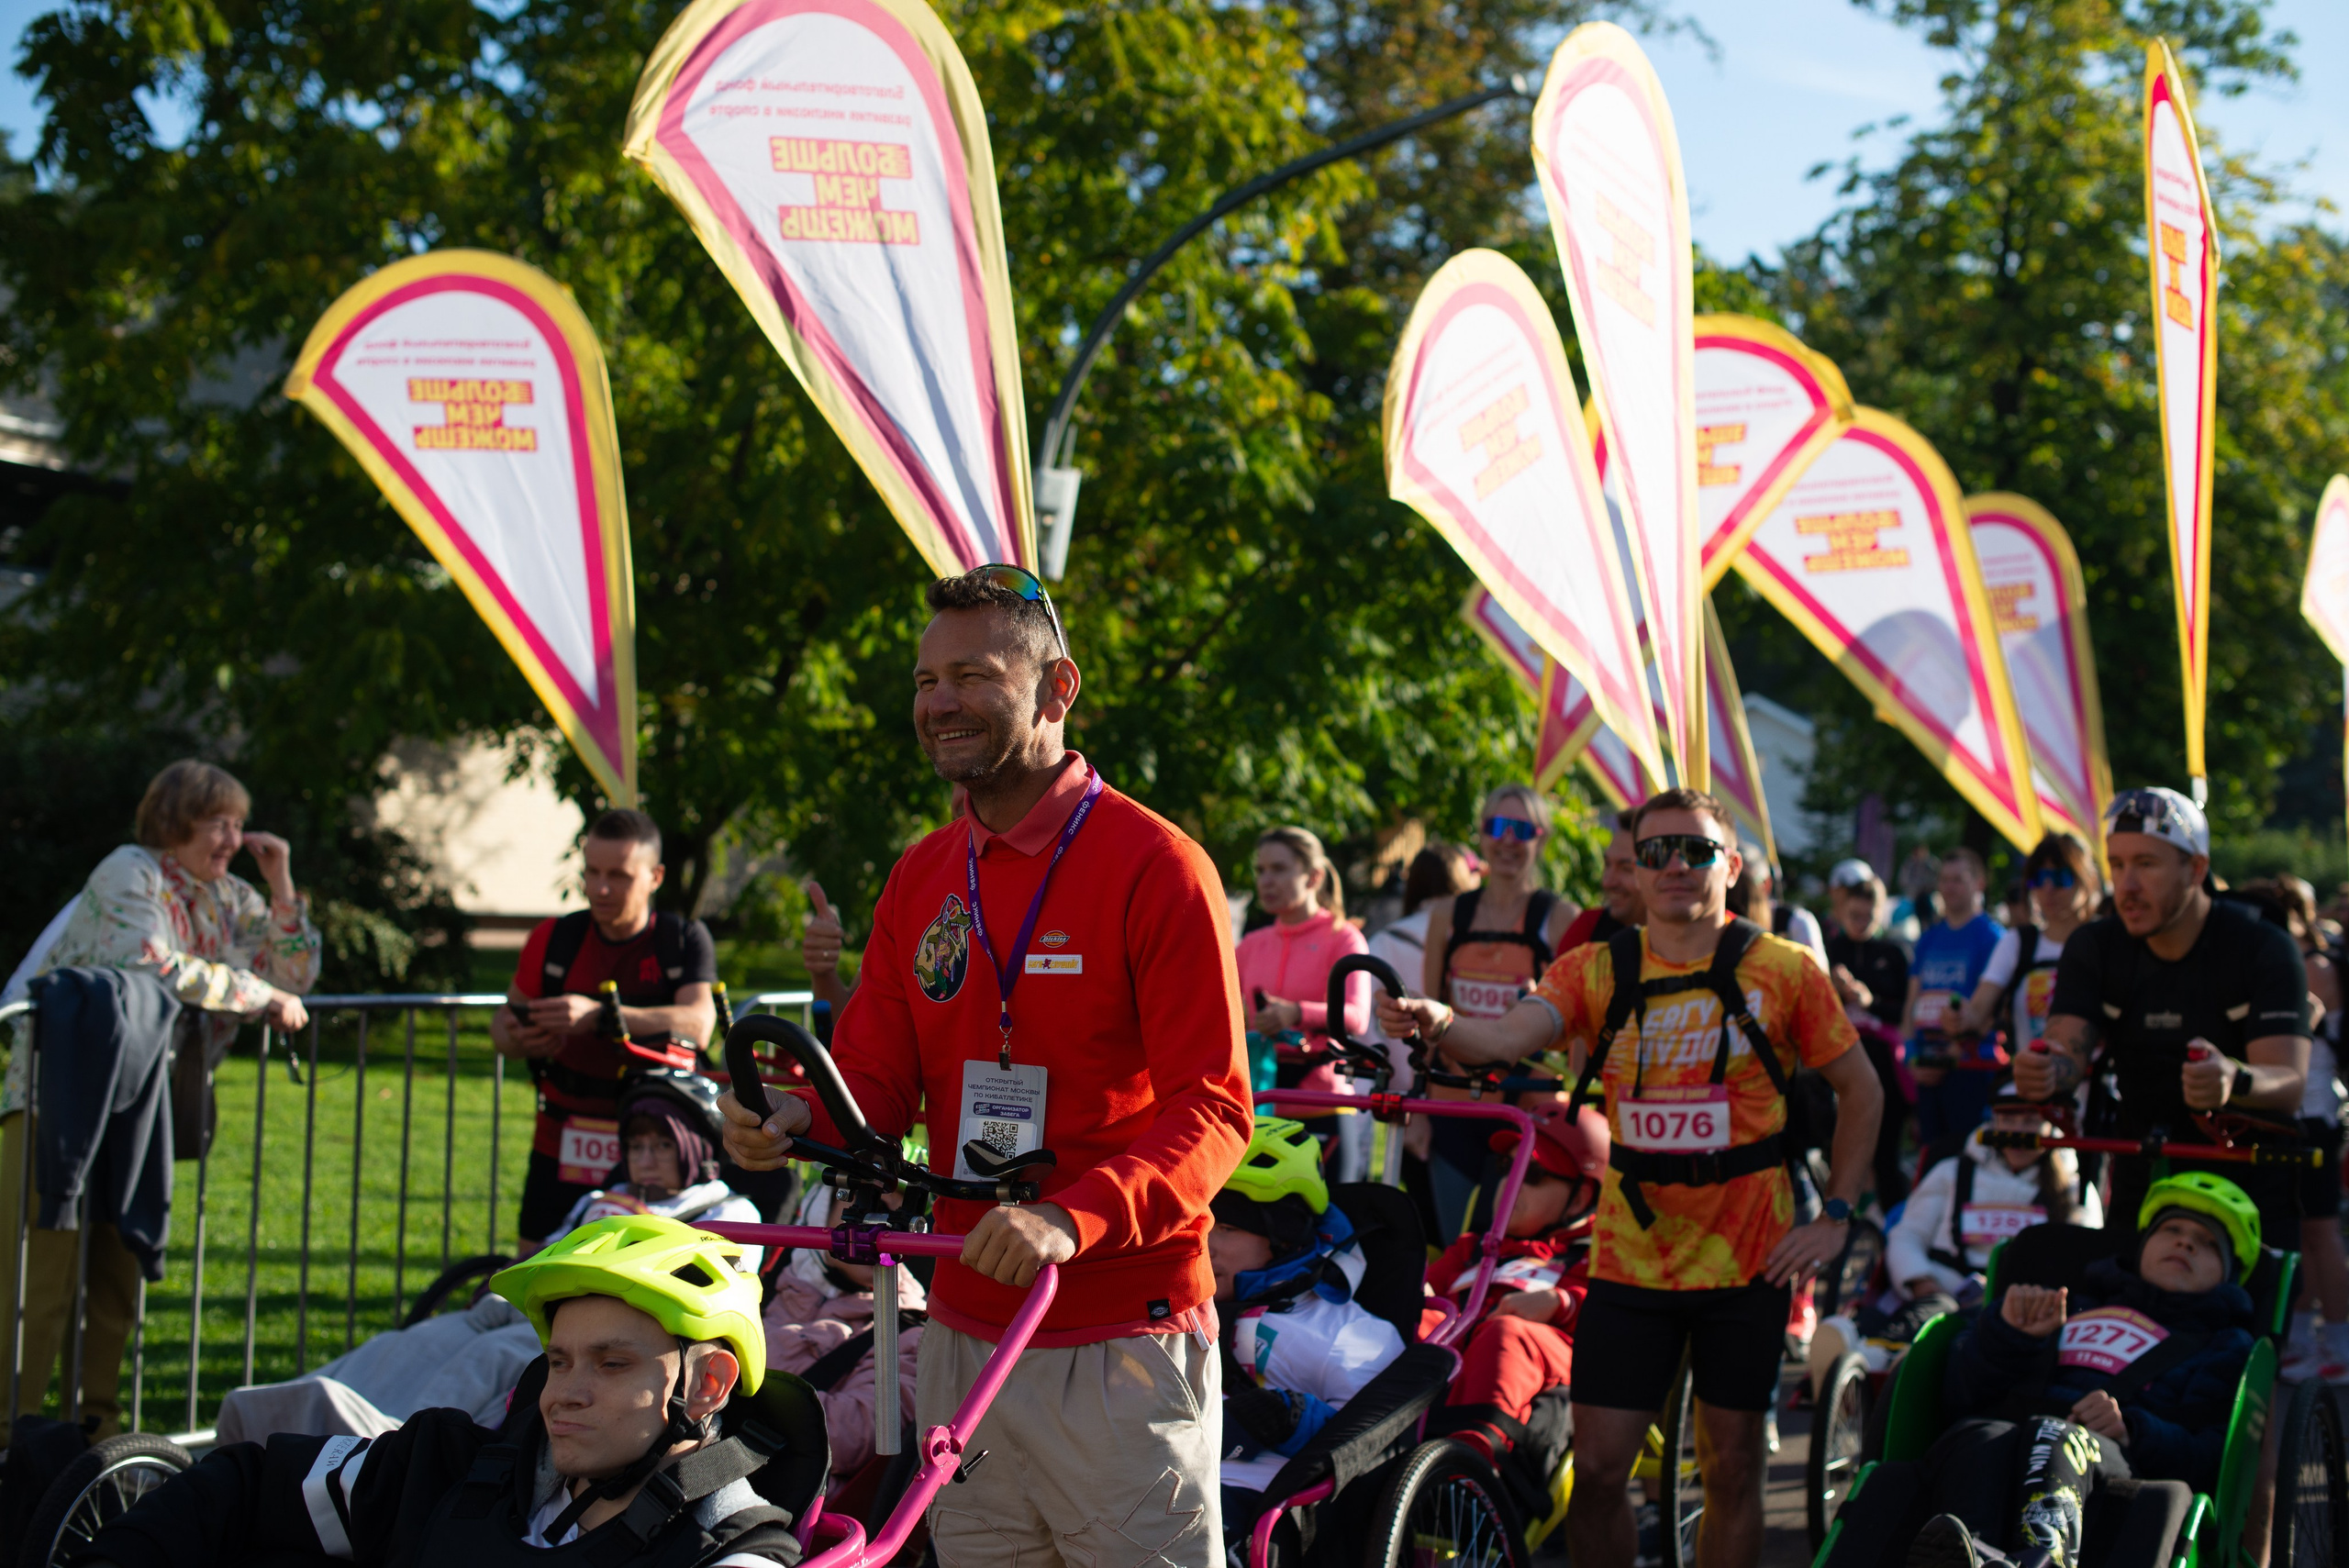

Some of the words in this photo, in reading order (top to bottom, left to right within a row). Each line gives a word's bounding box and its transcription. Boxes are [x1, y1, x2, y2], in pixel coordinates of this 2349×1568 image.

[1068, 800, 1090, 835] ФЕНИКС
[972, 901, 983, 937] ФЕНИКС
[967, 1084, 1009, 1093] ЧЕМПИОНАТ
[1010, 1087, 1041, 1095] МОСКВЫ
[985, 1077, 1024, 1086] ОТКРЫТЫЙ
[985, 1093, 1033, 1103] КИБАТЛЕТИКЕ
[992, 1105, 1030, 1113] ОРГАНИЗАТОР
[1630, 1110, 1714, 1140] 1076
[573, 1137, 621, 1162] 109
[2066, 1324, 2149, 1354] 1277
[2076, 1351, 2091, 1361] 11
[2035, 1419, 2066, 1442] THE
[2026, 1444, 2053, 1475] WIN
